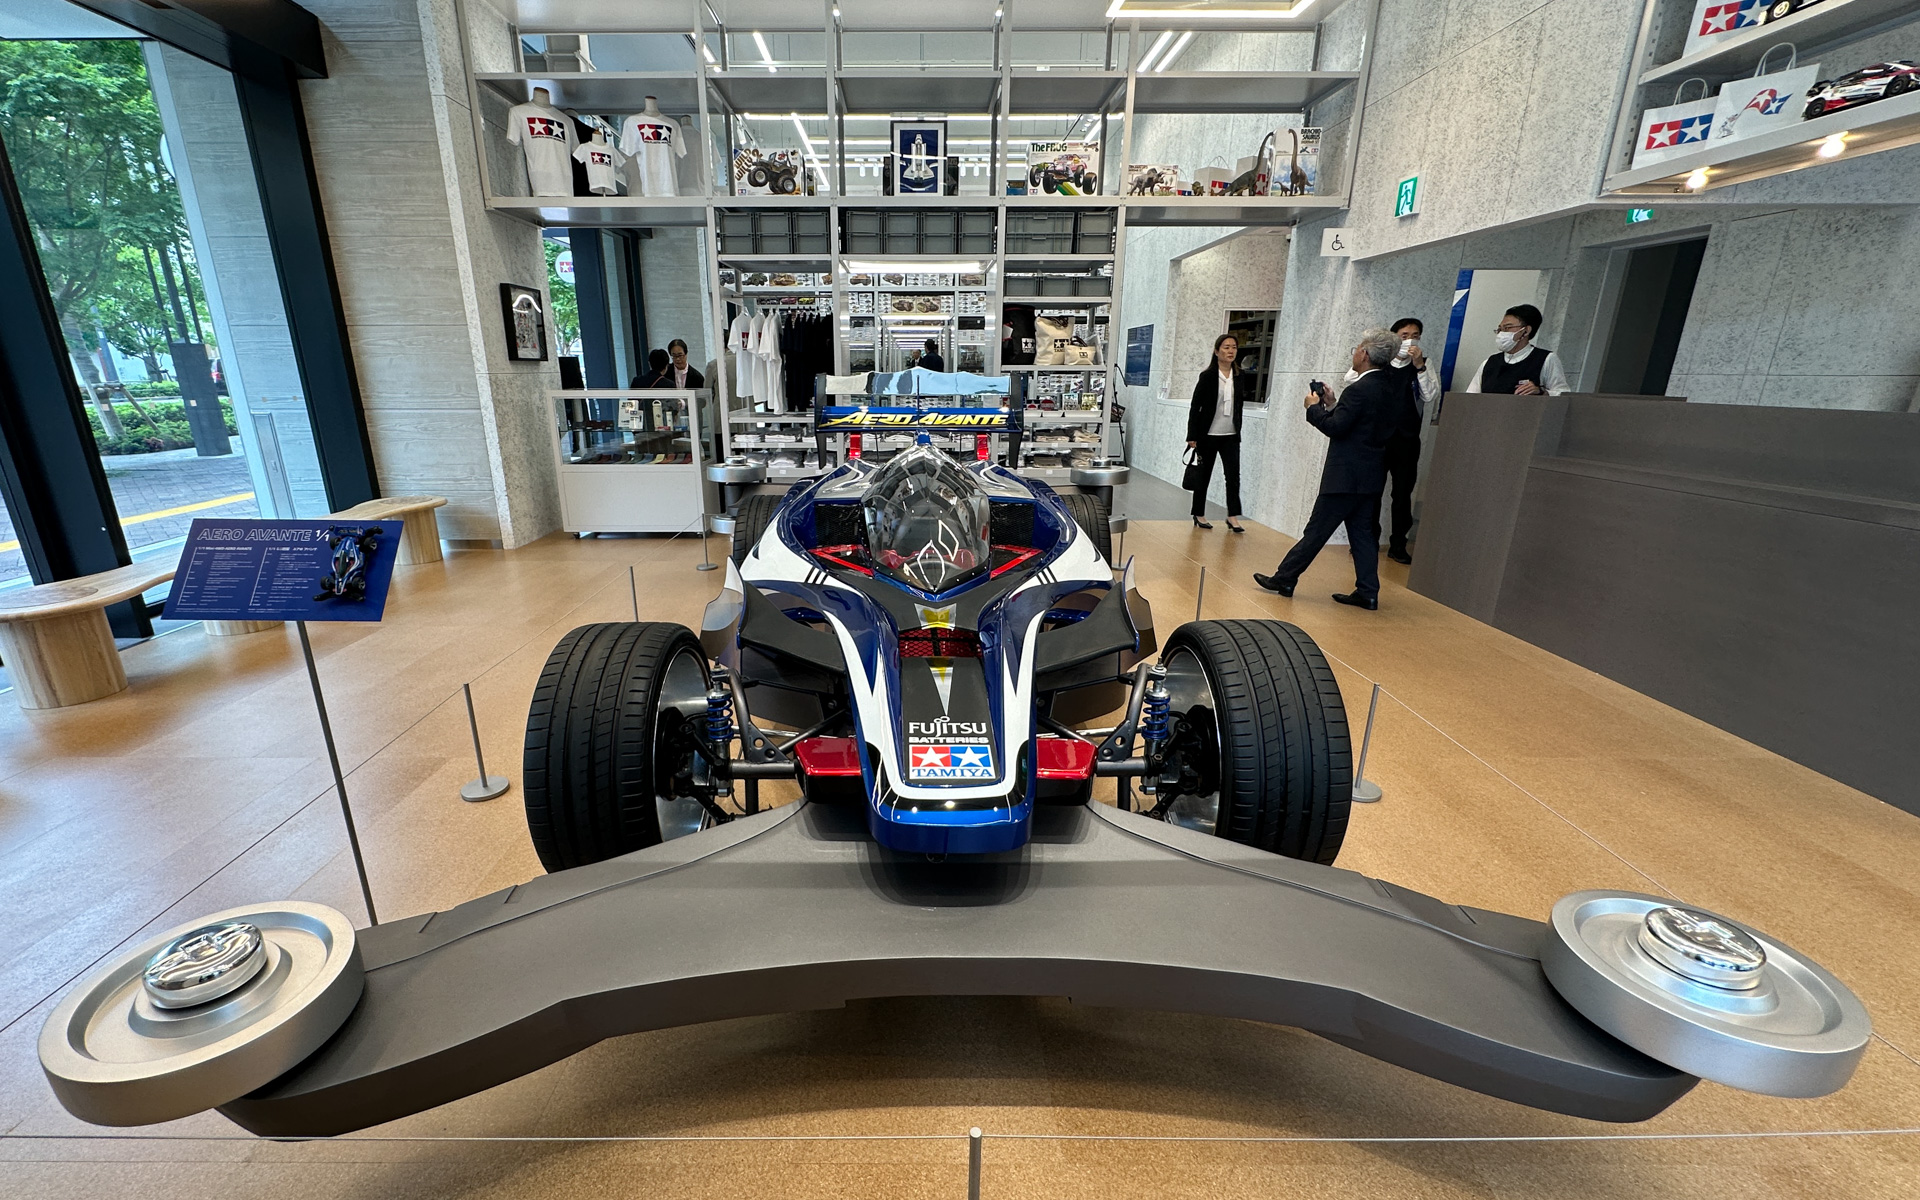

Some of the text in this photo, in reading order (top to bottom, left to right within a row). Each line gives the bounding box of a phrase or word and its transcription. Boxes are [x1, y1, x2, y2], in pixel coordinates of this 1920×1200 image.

[1031, 142, 1067, 152] The FROG
[734, 149, 752, 169] WILD
[734, 156, 753, 181] WILLY
[826, 411, 1009, 426] AERO AVANTE
[196, 528, 330, 542] AERO AVANTE 1/1
[908, 716, 987, 737] FUJITSU
[908, 736, 989, 744] BATTERIES
[911, 768, 993, 777] TAMIYA
